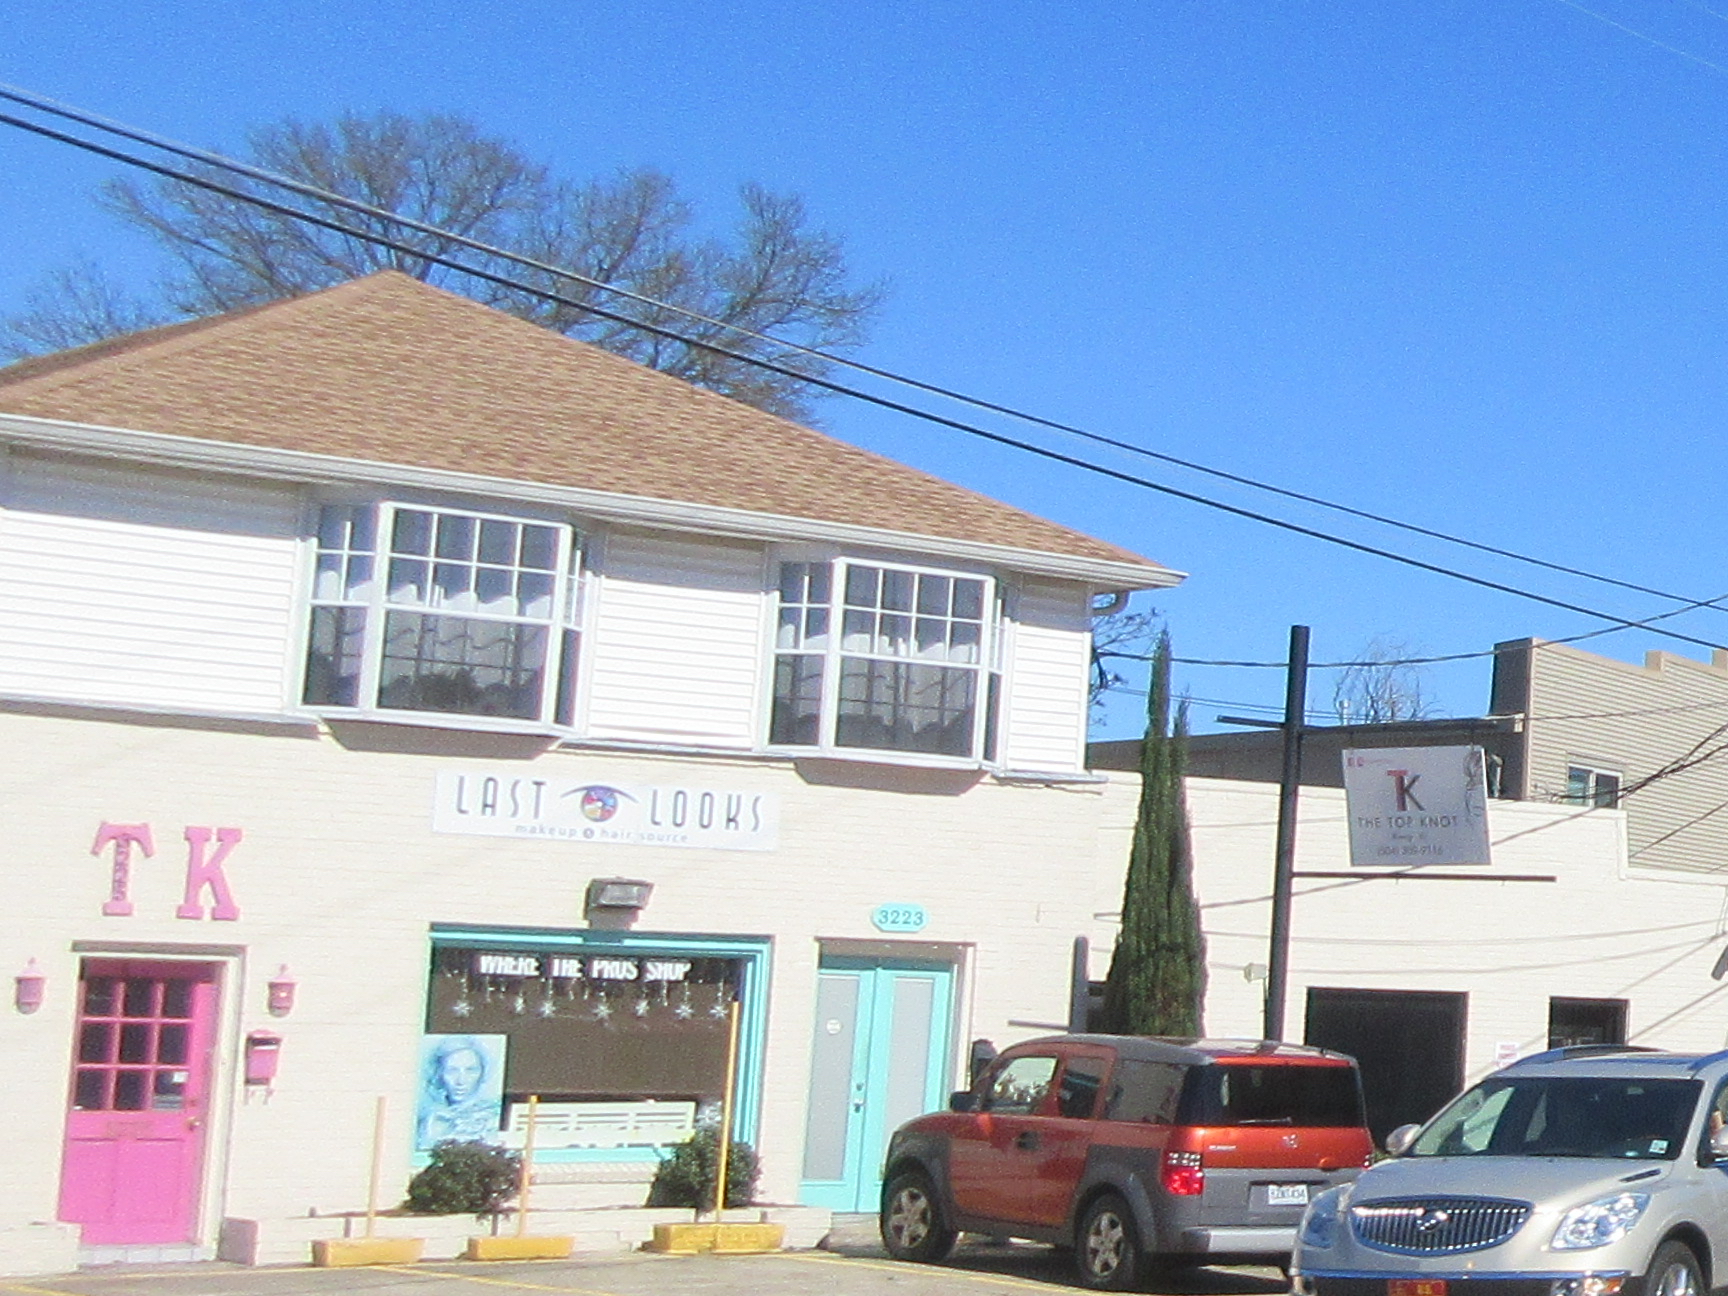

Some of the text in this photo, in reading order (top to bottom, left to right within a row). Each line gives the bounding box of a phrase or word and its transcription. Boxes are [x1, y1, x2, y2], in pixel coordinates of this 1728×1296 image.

[456, 775, 763, 832] LAST LOOKS
[1358, 815, 1458, 828] THE TOP KNOT
[515, 823, 577, 839] makeup
[601, 828, 631, 841] hair
[640, 832, 688, 843] source
[878, 909, 924, 927] 3223
